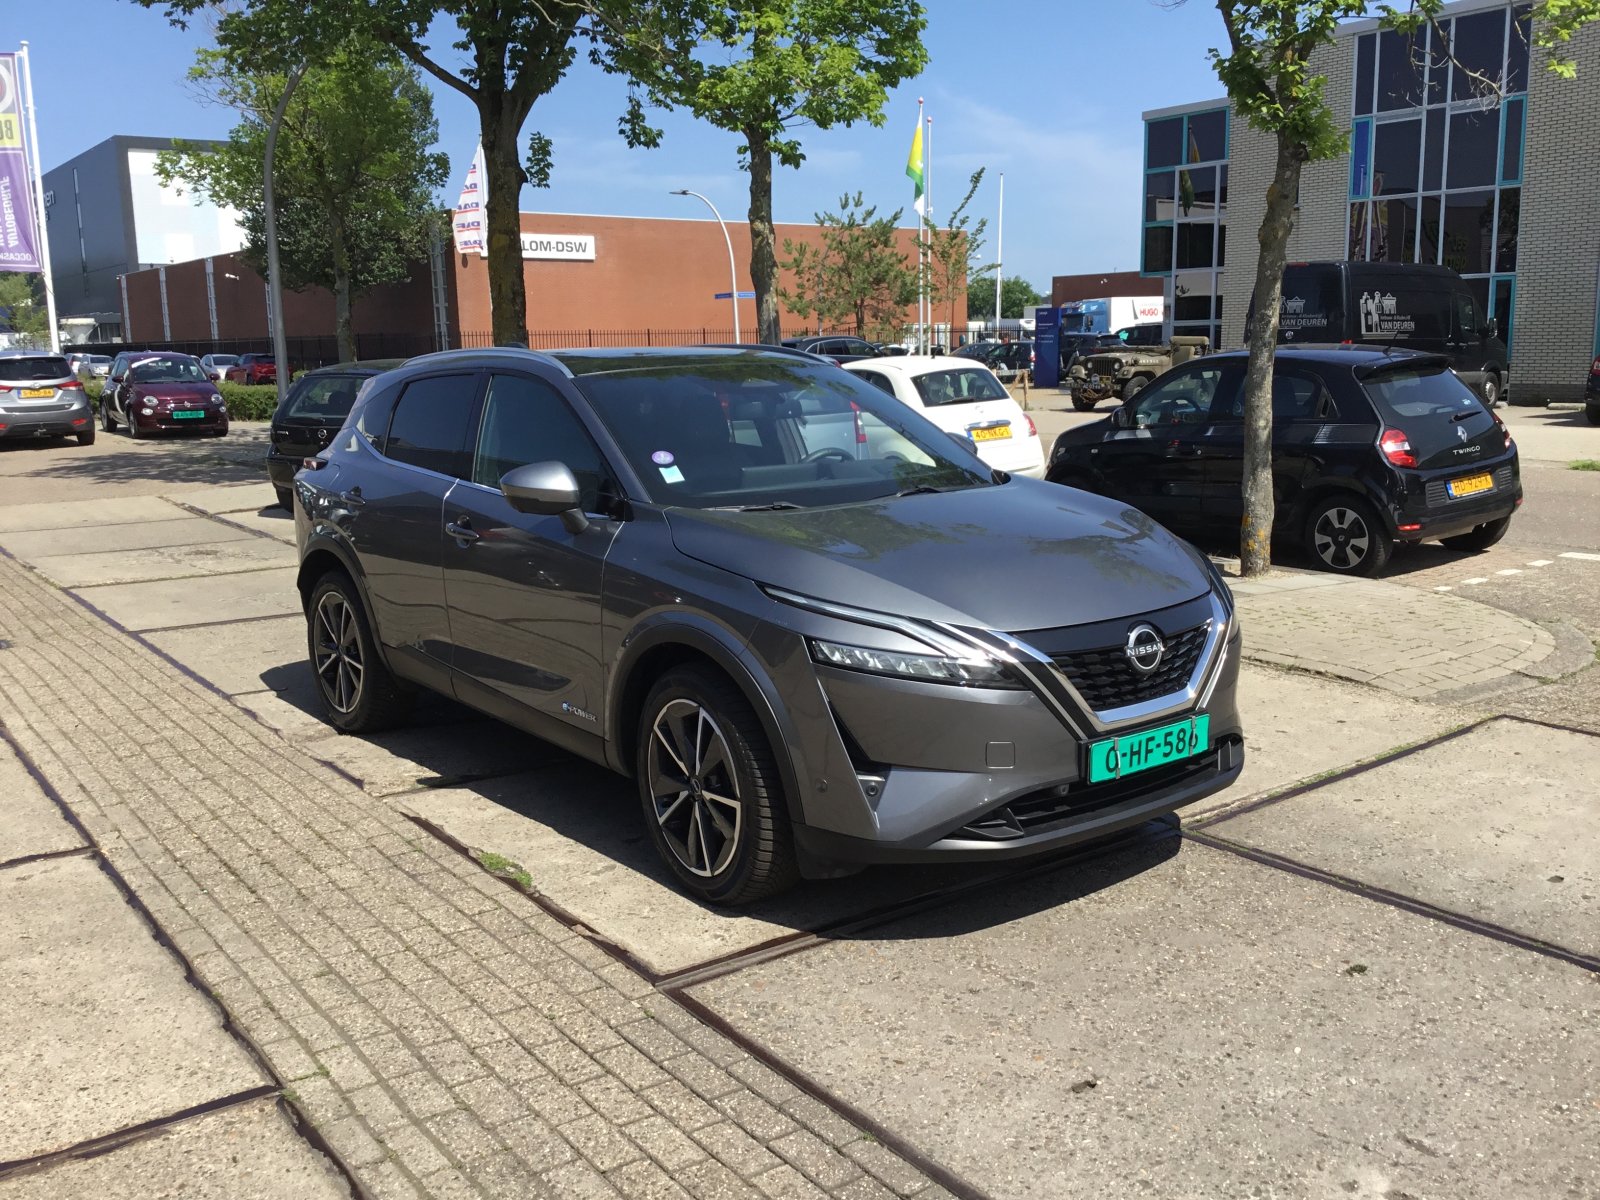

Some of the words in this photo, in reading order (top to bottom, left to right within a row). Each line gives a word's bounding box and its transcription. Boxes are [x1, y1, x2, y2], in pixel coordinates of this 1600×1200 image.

[521, 240, 587, 253] LOM-DSW
[1139, 307, 1159, 317] HUGO
[1297, 318, 1328, 327] DEUREN
[1380, 320, 1393, 330] VAN
[1393, 320, 1415, 330] DEUREN
[1453, 445, 1480, 456] TWINGO
[1127, 642, 1163, 657] NISSAN
